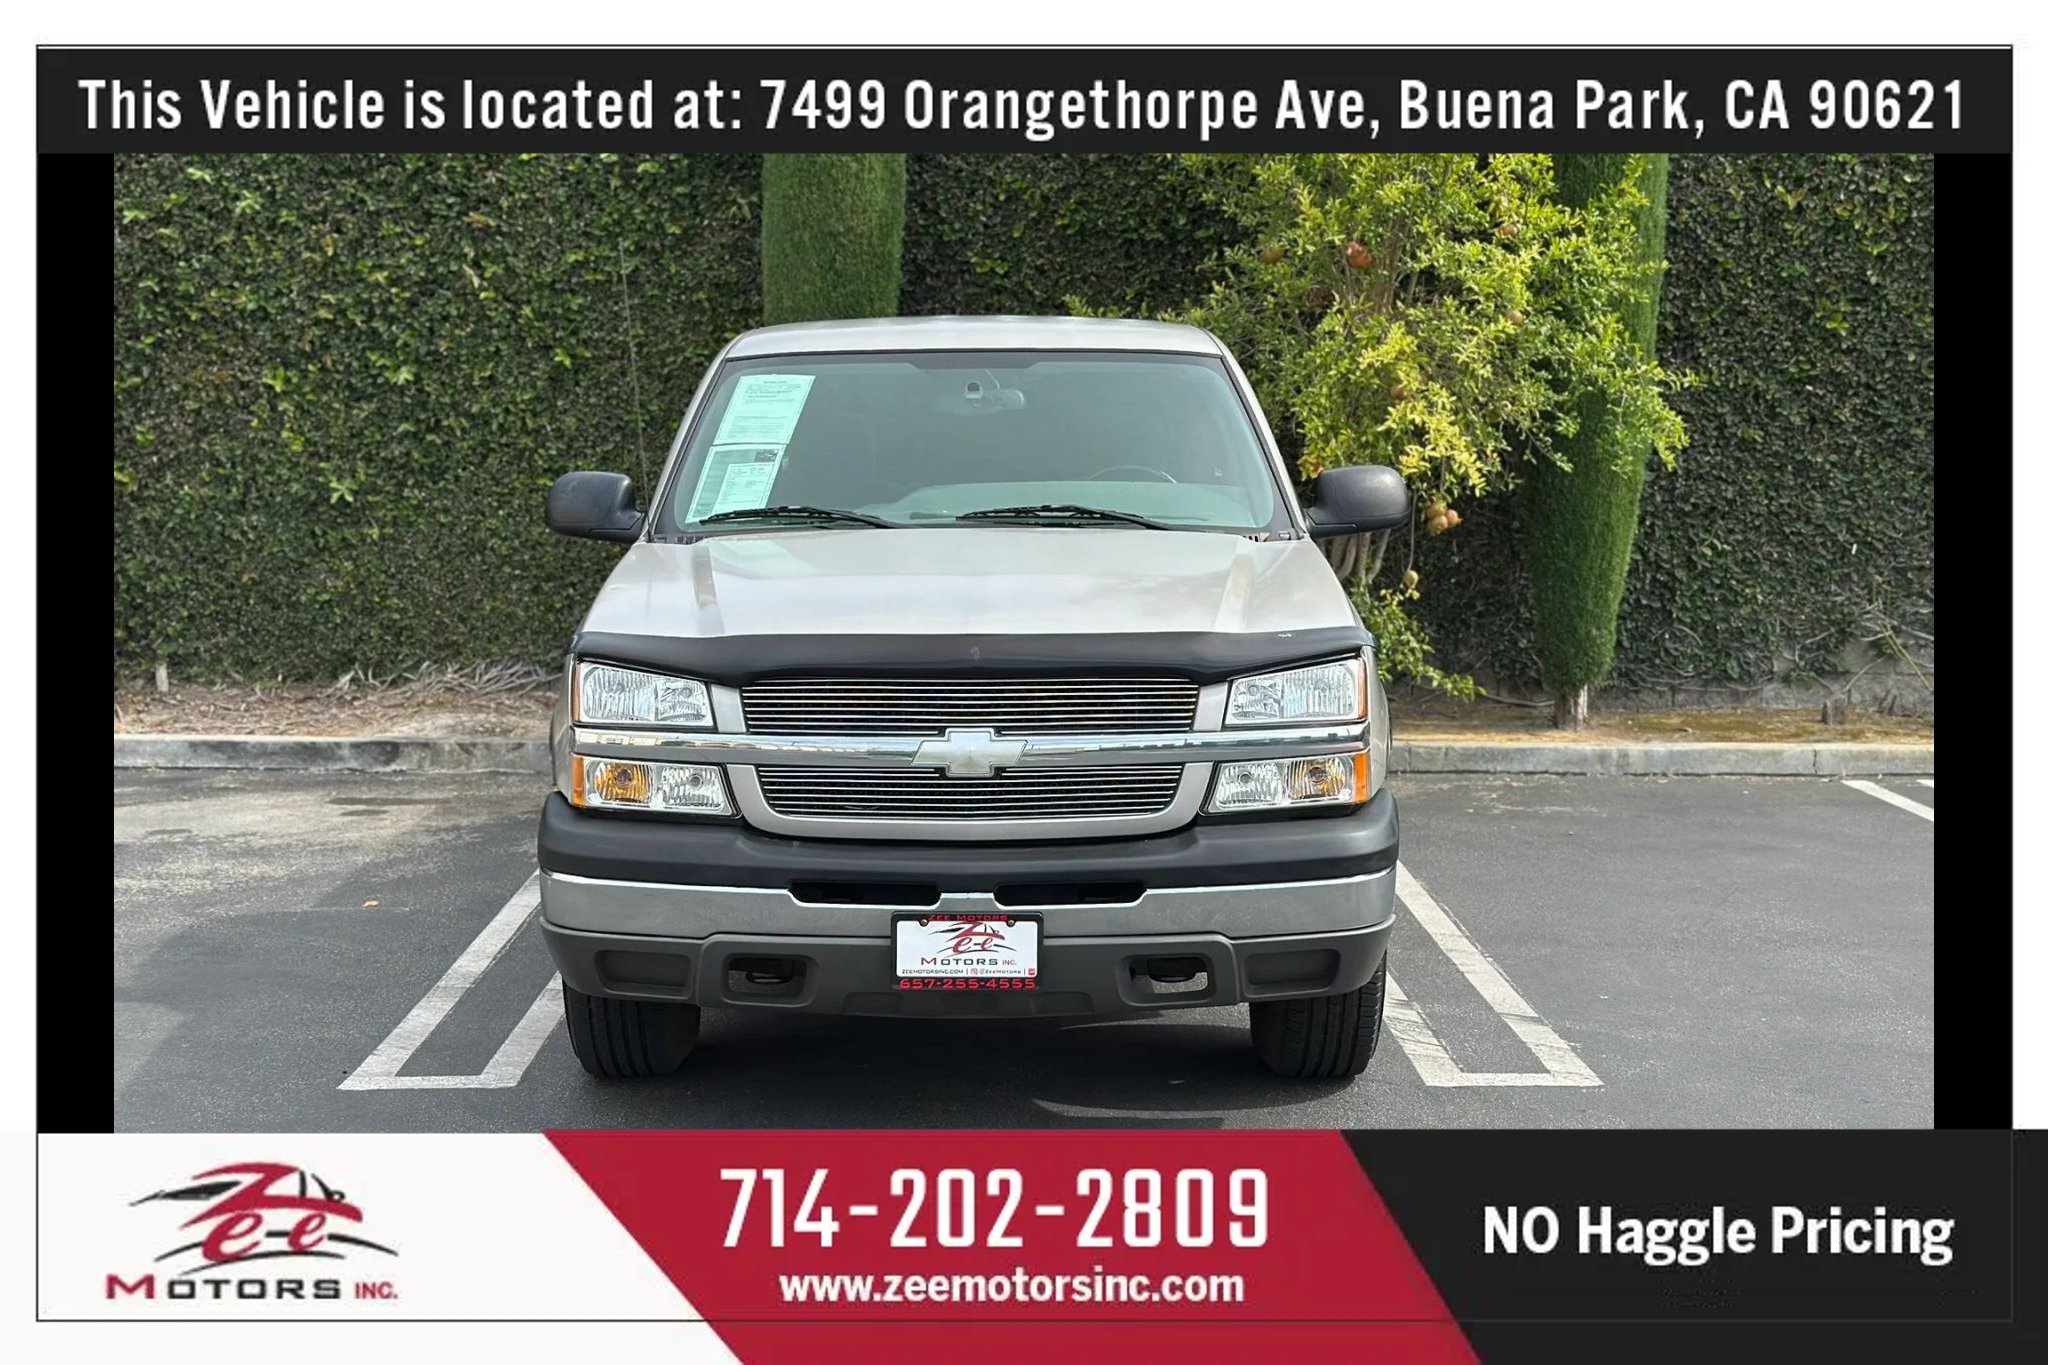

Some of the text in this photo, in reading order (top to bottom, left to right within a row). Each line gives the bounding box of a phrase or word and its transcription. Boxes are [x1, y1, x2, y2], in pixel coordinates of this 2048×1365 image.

[928, 914, 1008, 922] ZEE MOTORS
[899, 978, 1036, 990] 657-255-4555
